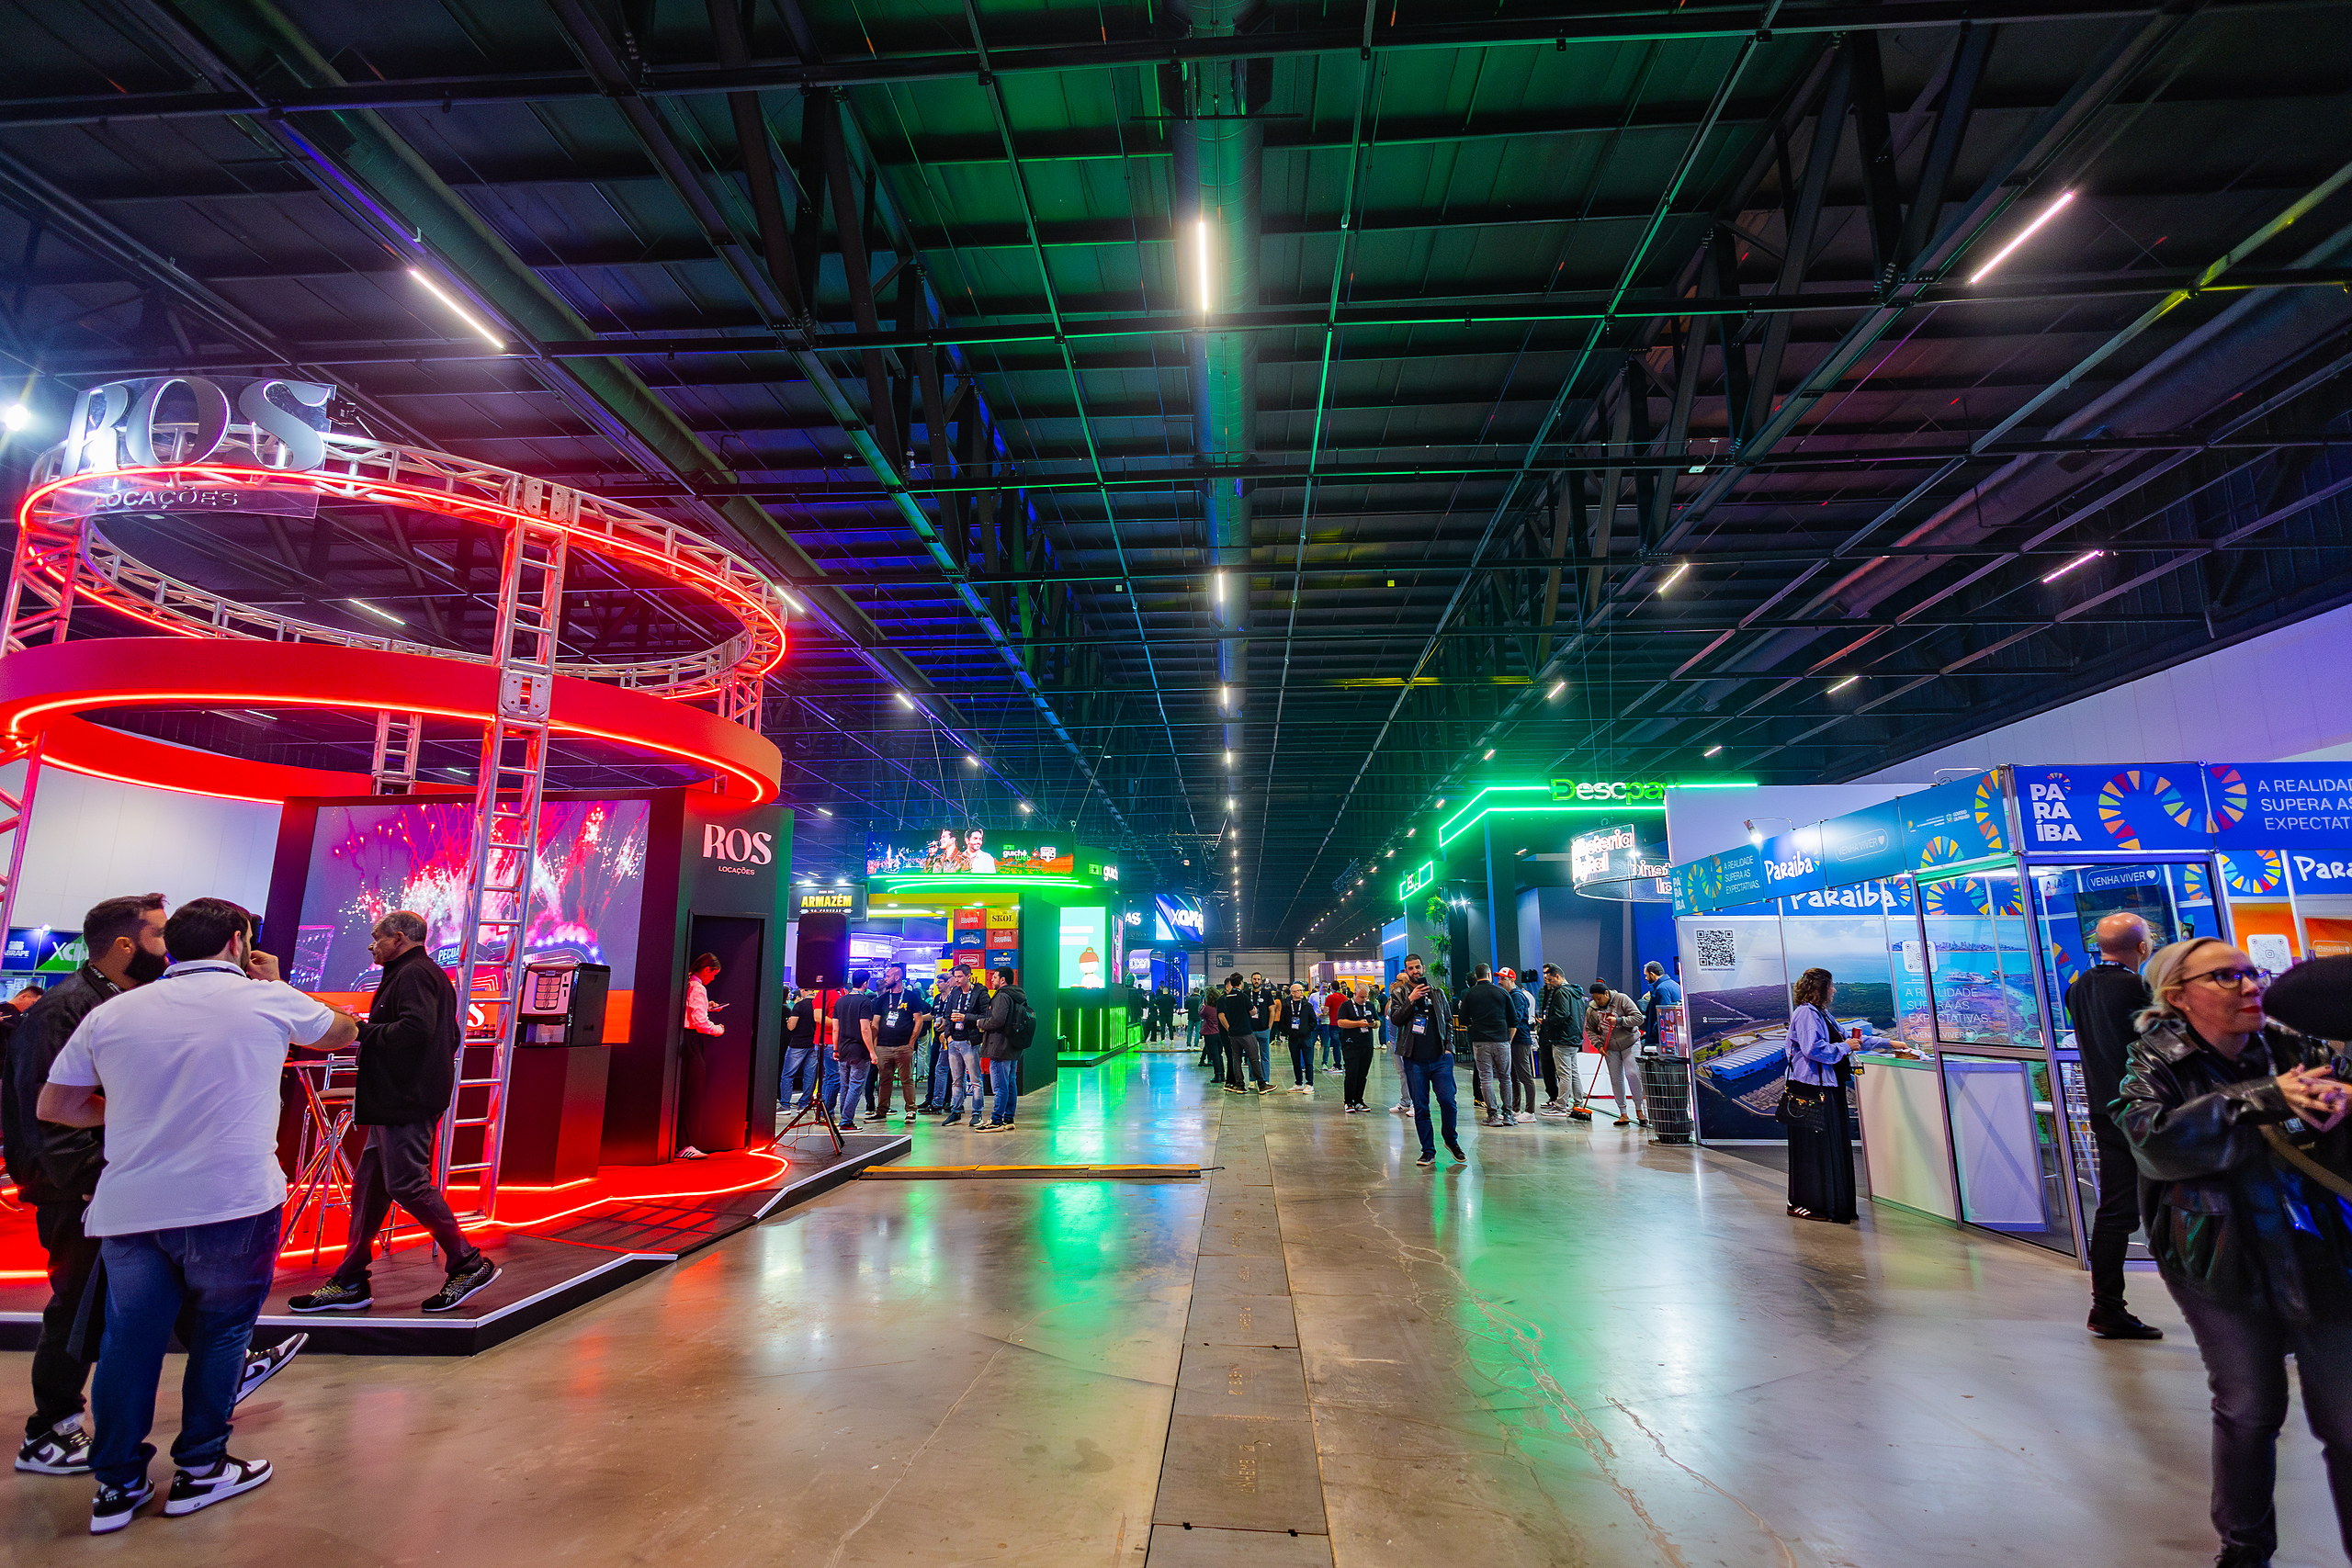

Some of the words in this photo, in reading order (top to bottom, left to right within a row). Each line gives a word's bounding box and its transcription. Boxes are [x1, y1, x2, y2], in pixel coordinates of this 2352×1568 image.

[61, 375, 330, 477] ROS
[94, 485, 239, 510] LOCAÇÕES
[1551, 778, 1676, 805] Descpa
[2030, 783, 2066, 801] PA
[2257, 779, 2270, 793] A
[2032, 802, 2072, 819] RA
[2260, 797, 2334, 812] SUPERA
[2036, 818, 2082, 842] ÍBA
[702, 823, 773, 865] ROS
[1727, 855, 1754, 869] REALIDADE
[718, 865, 755, 875] LOCAÇÕES
[1724, 870, 1744, 883] SUPERA
[1743, 869, 1750, 878] AS
[2090, 874, 2120, 887] VENHA
[2120, 871, 2146, 884] VIVER
[800, 893, 853, 908] ARMAZÉM
[992, 914, 1013, 922] SKOL
[1905, 987, 1914, 997] A
[1906, 1000, 1952, 1010] SUPRA
[1954, 1000, 1970, 1010] AS
[1908, 1013, 1991, 1023] EXPCTATIVAS.
